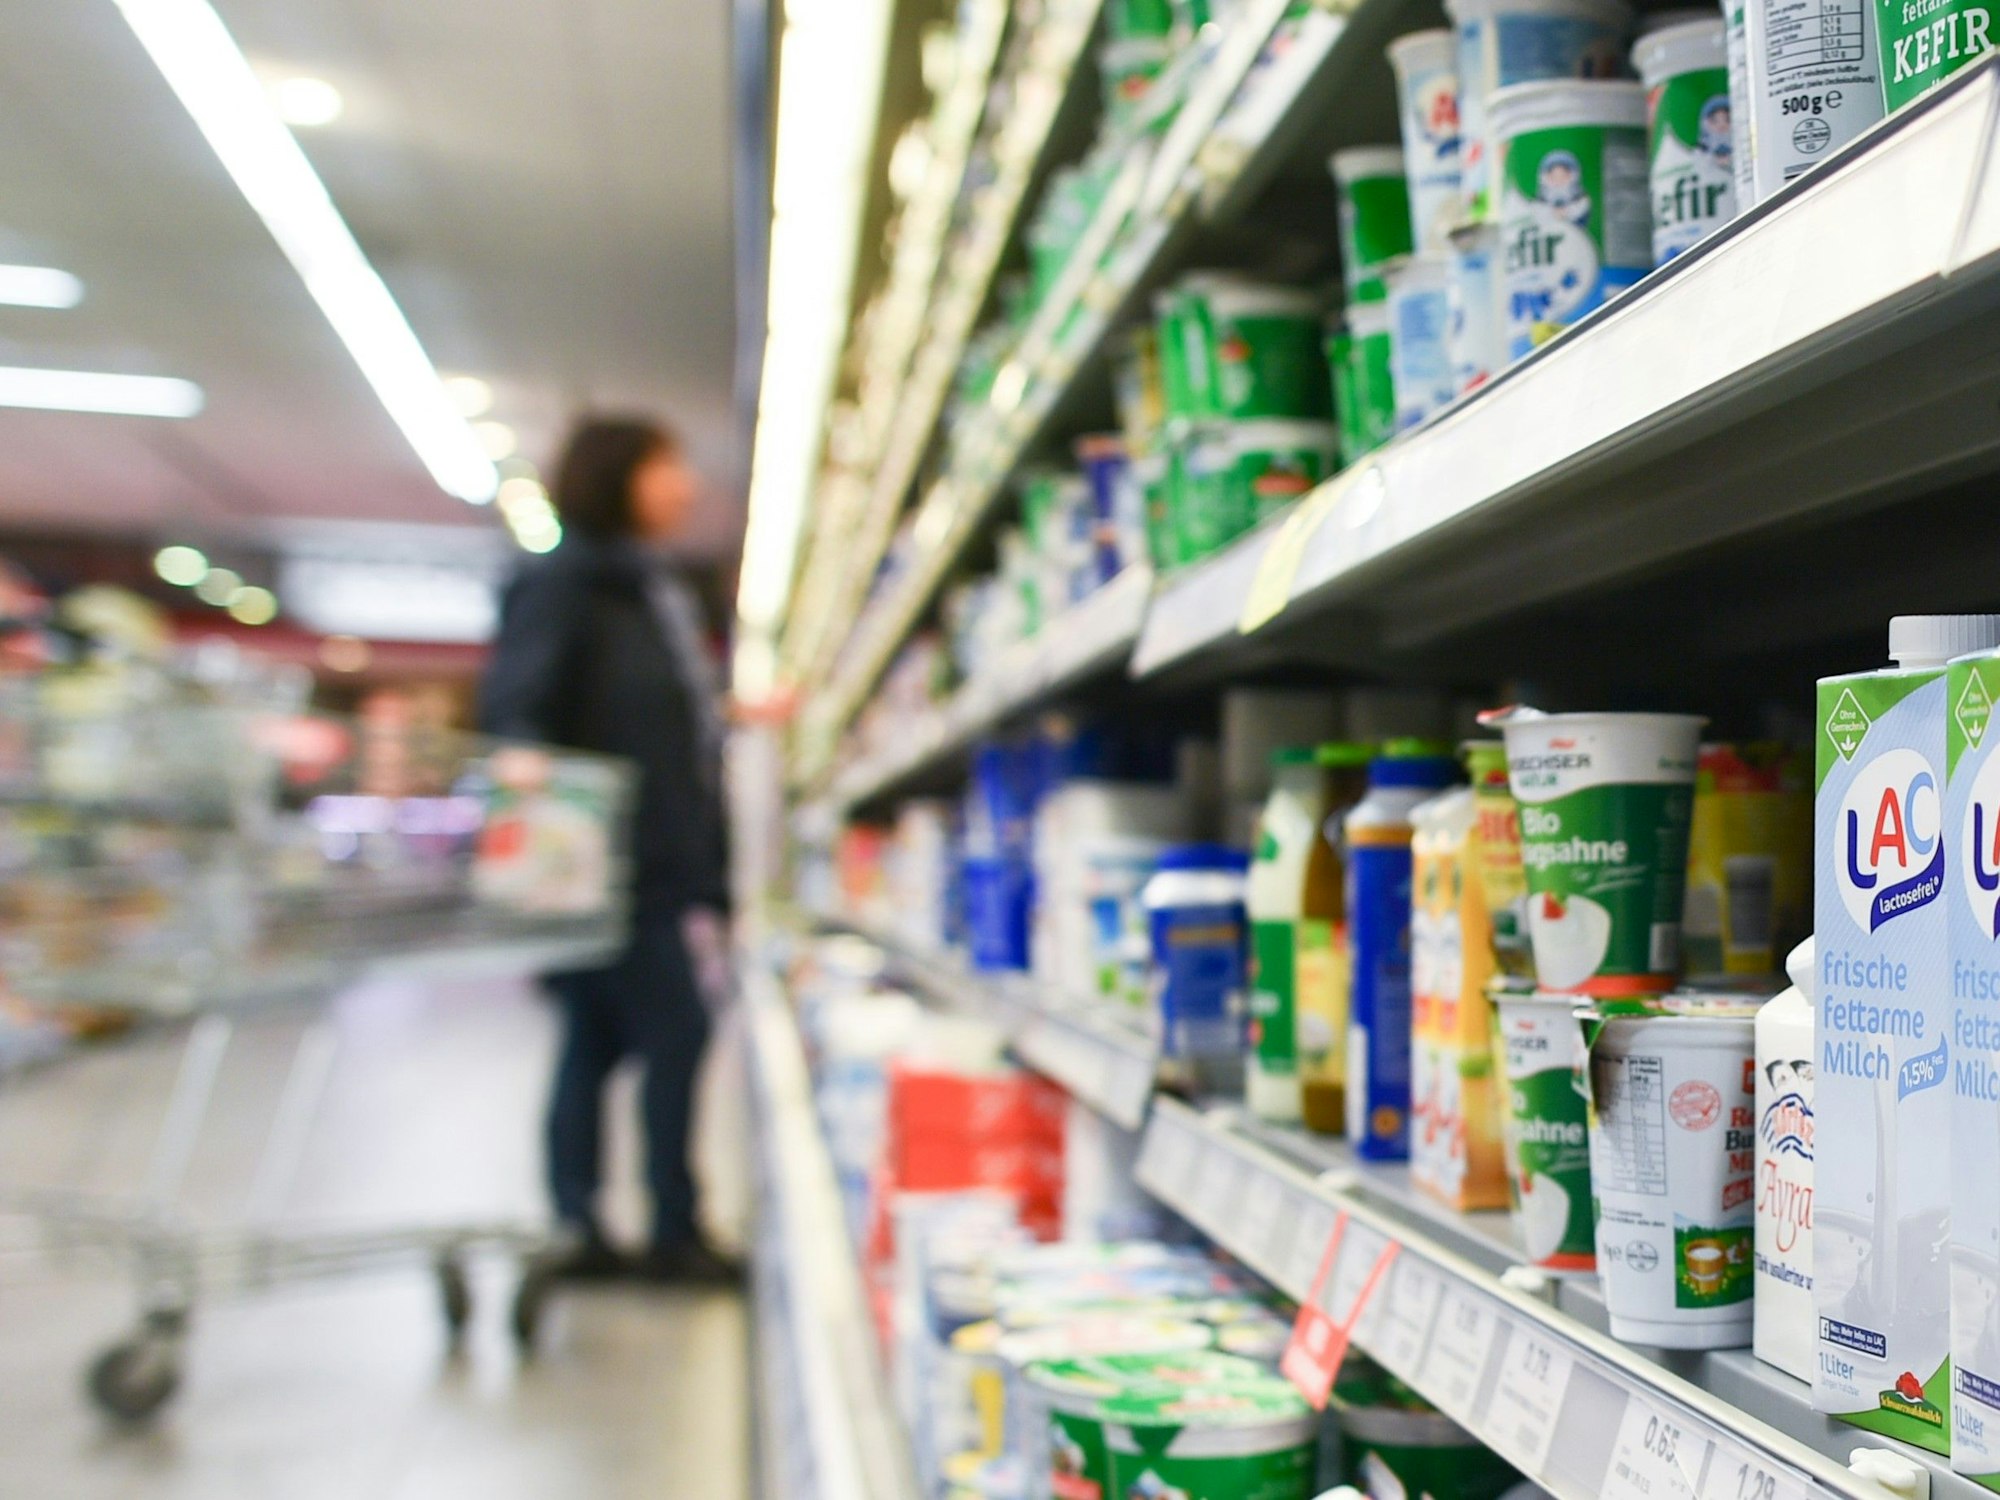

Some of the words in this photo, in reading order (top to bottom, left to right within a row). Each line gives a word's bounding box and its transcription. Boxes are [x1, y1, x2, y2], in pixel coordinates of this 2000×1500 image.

[1893, 8, 1995, 84] KEFIR
[1847, 771, 1934, 889] LAC
[1824, 951, 1907, 991] frische
[1955, 959, 2000, 1001] frisc
[1824, 995, 1924, 1039] fettarme
[1955, 1008, 2000, 1051] fetta
[1823, 1040, 1889, 1080] Milch
[1902, 1058, 1934, 1089] 1,5%
[1955, 1059, 2000, 1101] Milc
[1758, 1160, 1813, 1252] Ayra
